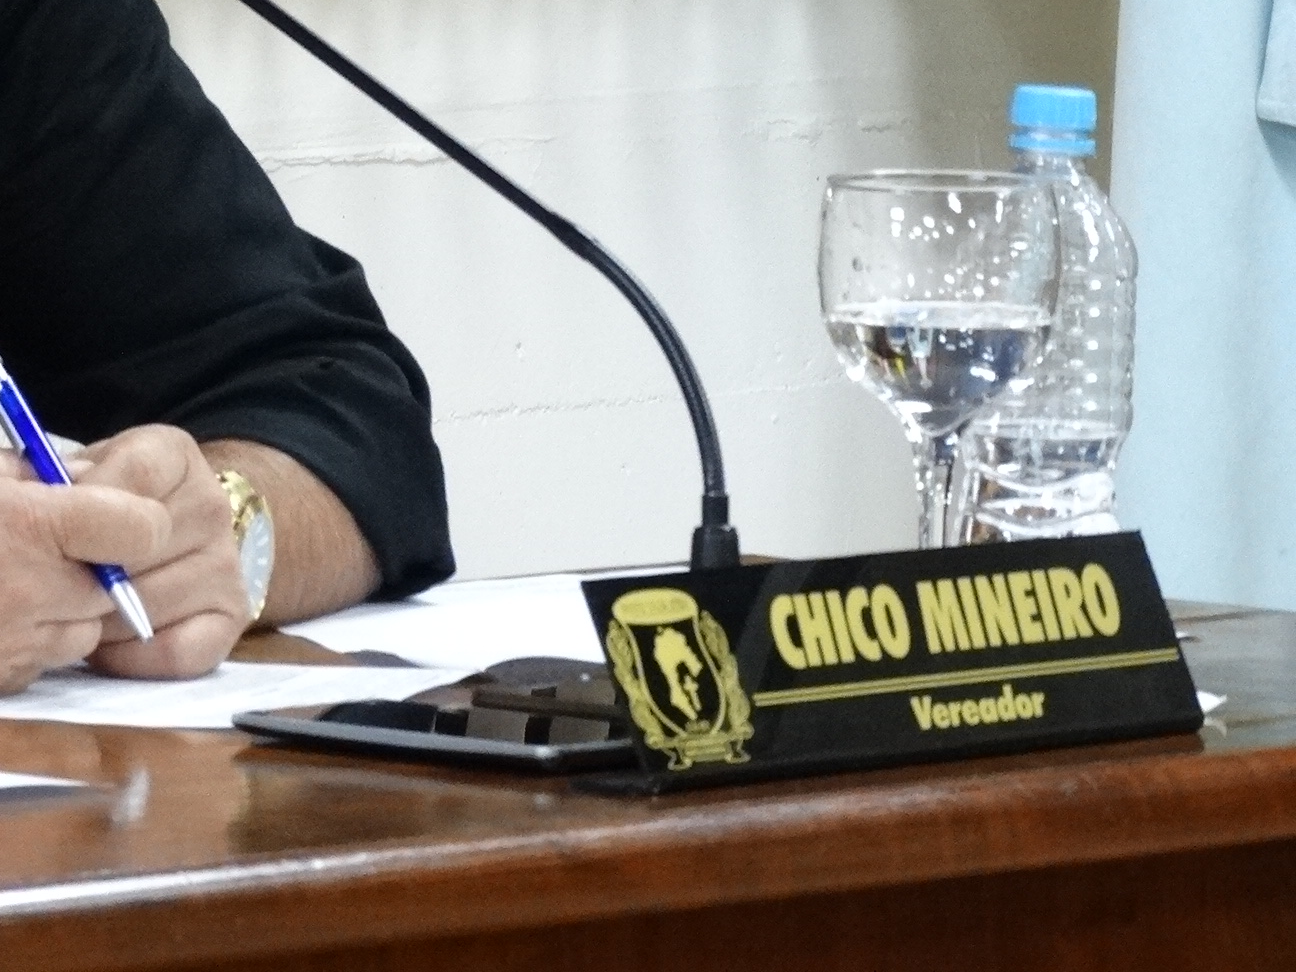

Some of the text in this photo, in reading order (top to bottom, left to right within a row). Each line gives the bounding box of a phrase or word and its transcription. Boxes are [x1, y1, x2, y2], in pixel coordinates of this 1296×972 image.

[770, 563, 1120, 669] CHICO MINEIRO
[910, 685, 1044, 730] Vereador
